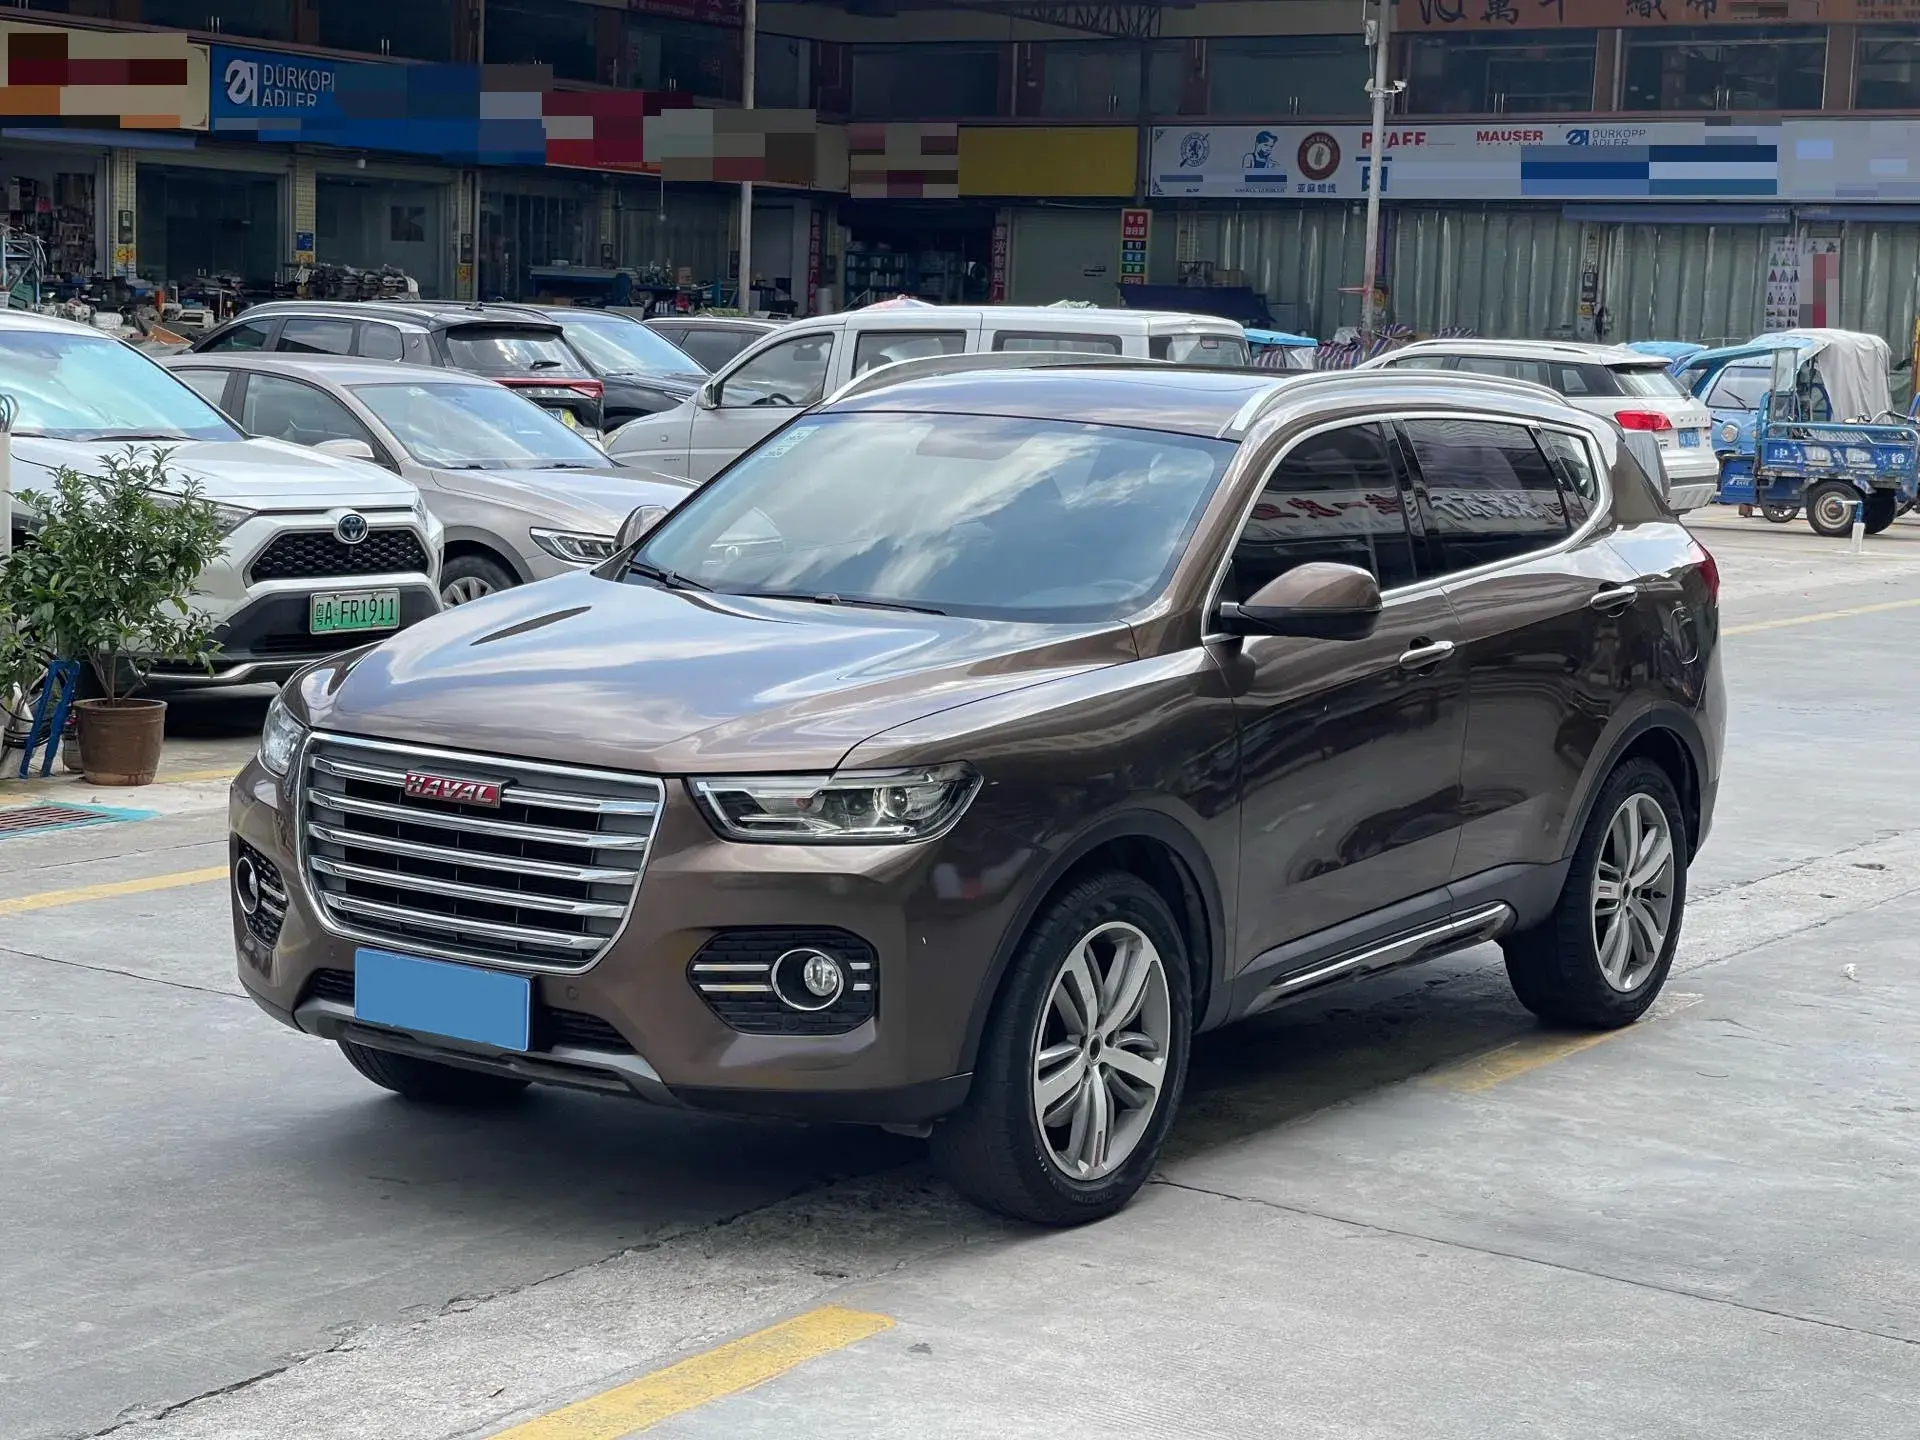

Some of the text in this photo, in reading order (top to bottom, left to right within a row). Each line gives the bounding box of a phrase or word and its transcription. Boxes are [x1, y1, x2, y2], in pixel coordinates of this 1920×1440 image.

[1361, 132, 1427, 149] PAFF
[1476, 130, 1544, 142] MAUSER
[315, 597, 394, 626] 粤AFR1911
[406, 775, 493, 803] HAVAL
